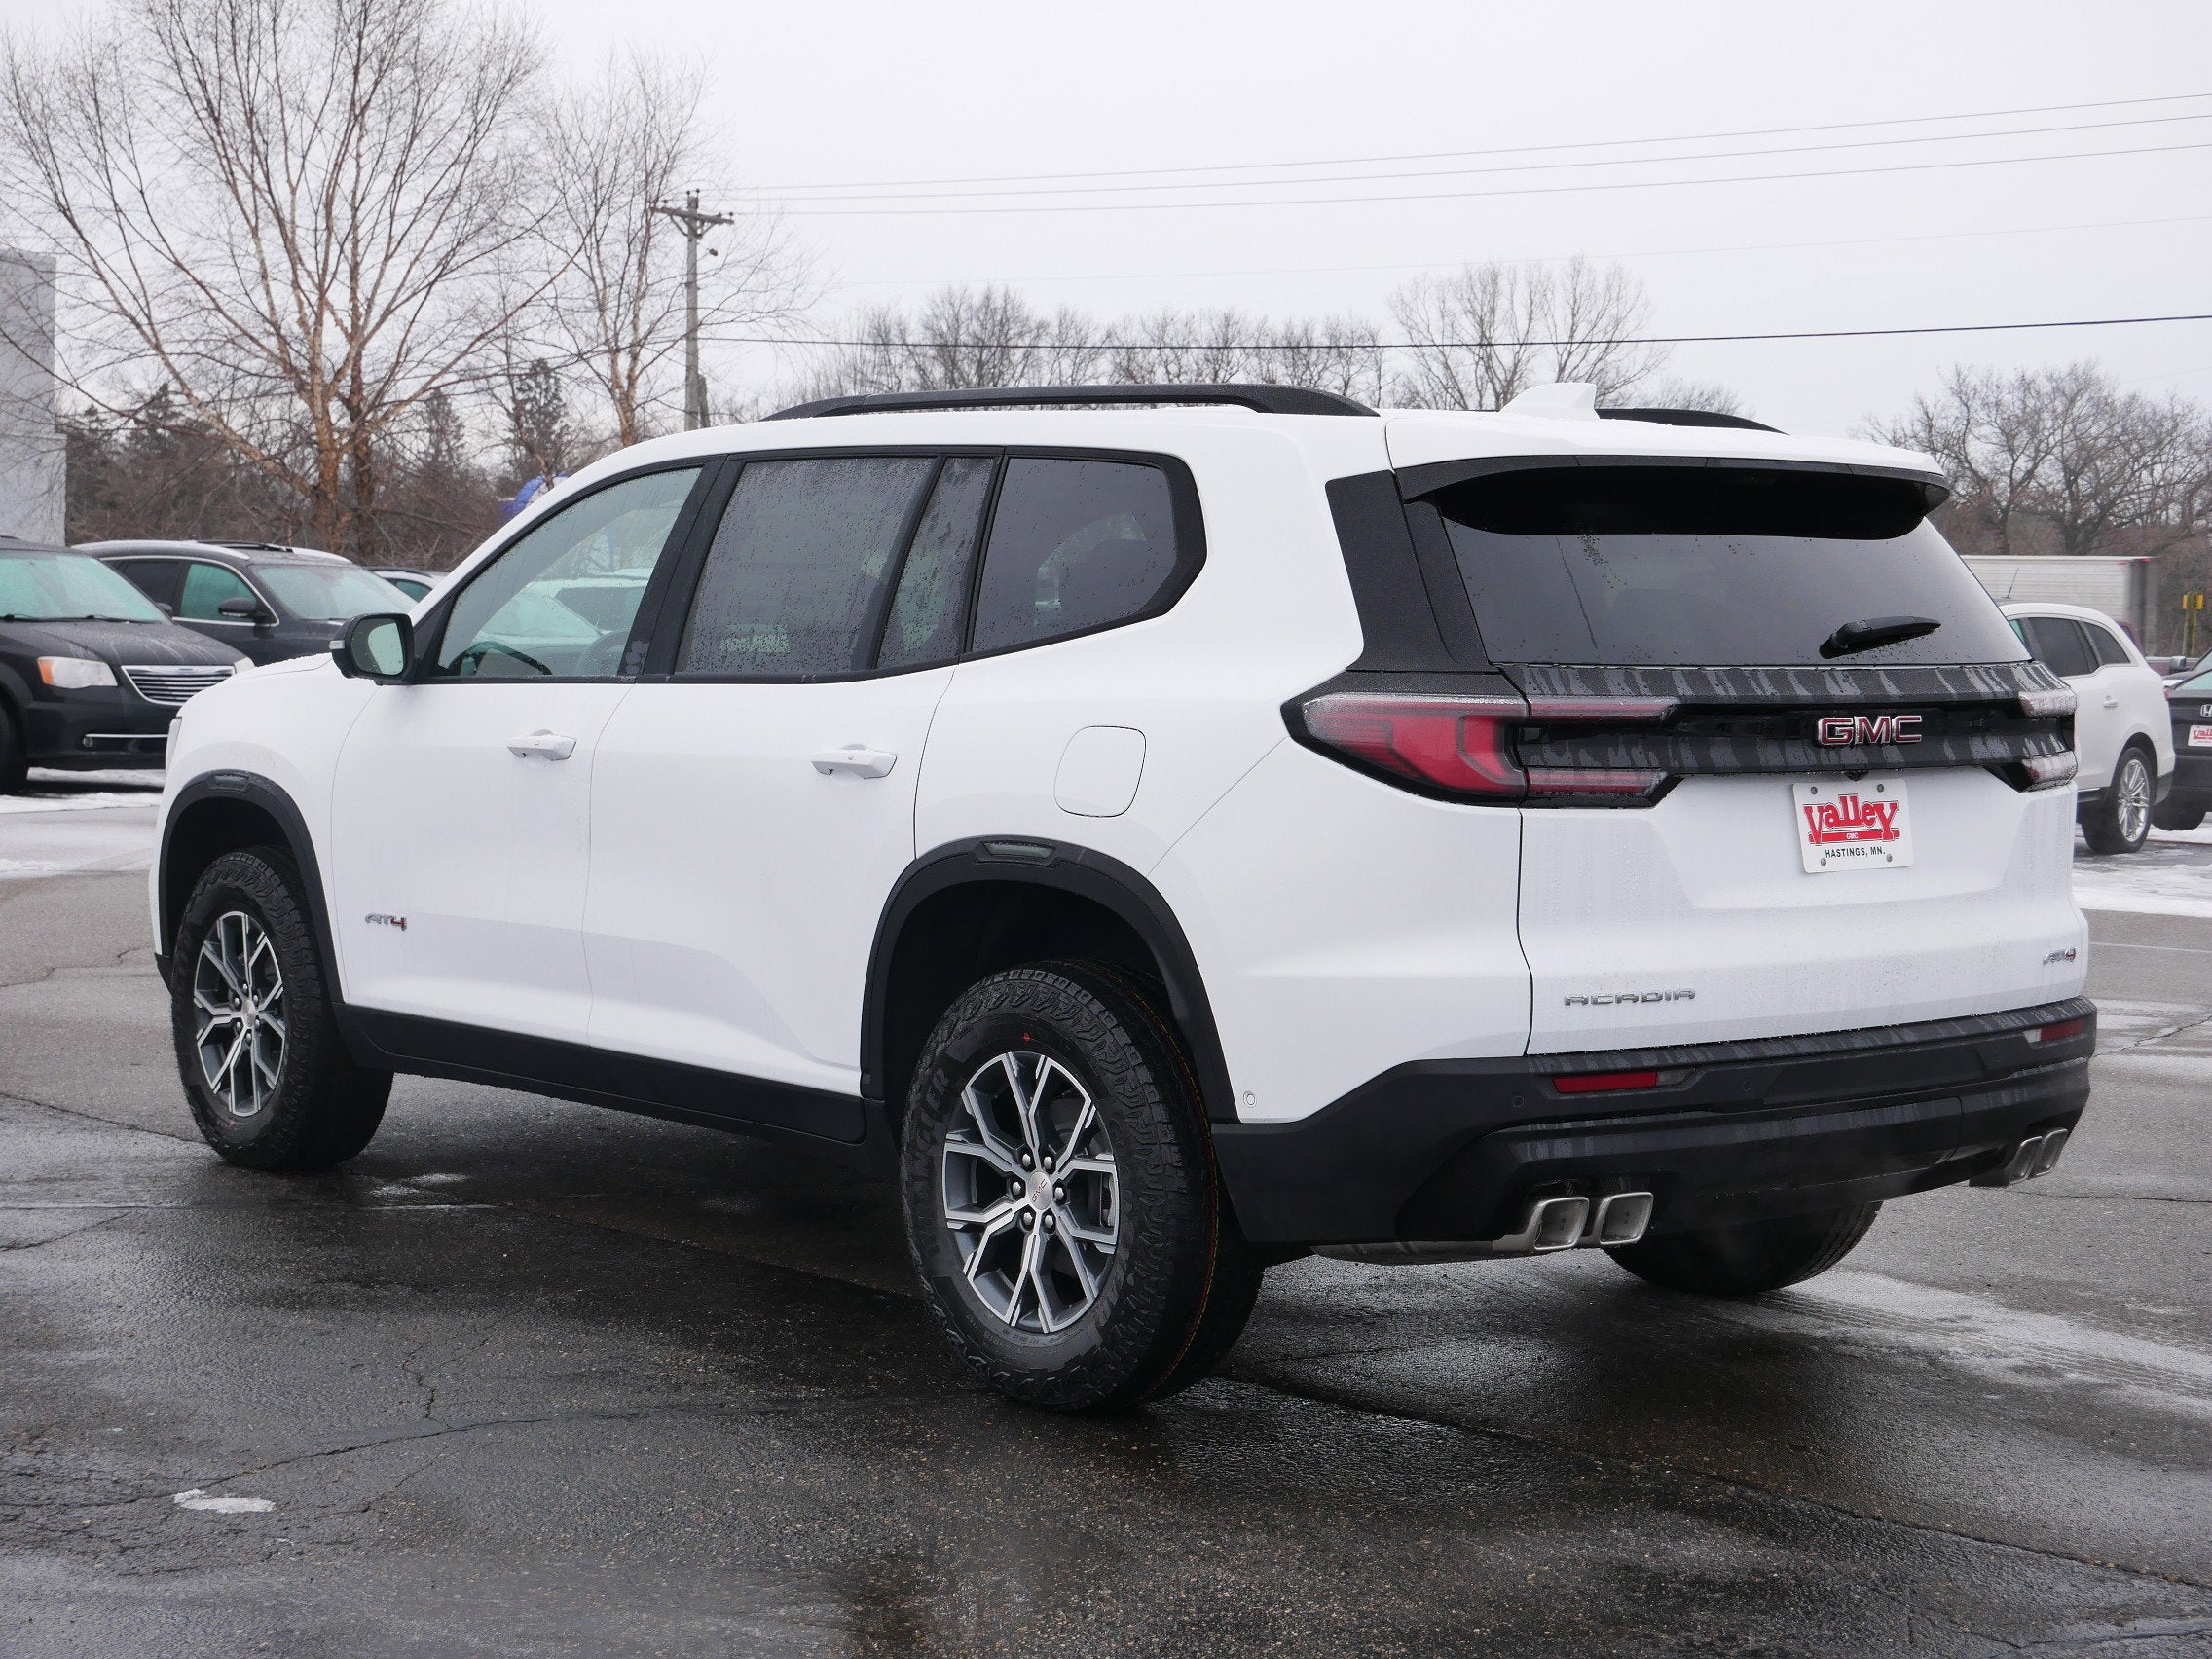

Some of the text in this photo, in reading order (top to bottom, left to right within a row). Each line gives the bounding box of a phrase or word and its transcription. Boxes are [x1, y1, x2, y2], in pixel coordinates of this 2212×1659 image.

[1818, 716, 1922, 745] GMC
[1803, 793, 1899, 845] Valley
[1825, 846, 1886, 858] HASTINGS, MN.
[365, 913, 407, 931] AT4
[1565, 989, 1695, 1006] ACADIA
[1032, 1178, 1048, 1203] GMC
